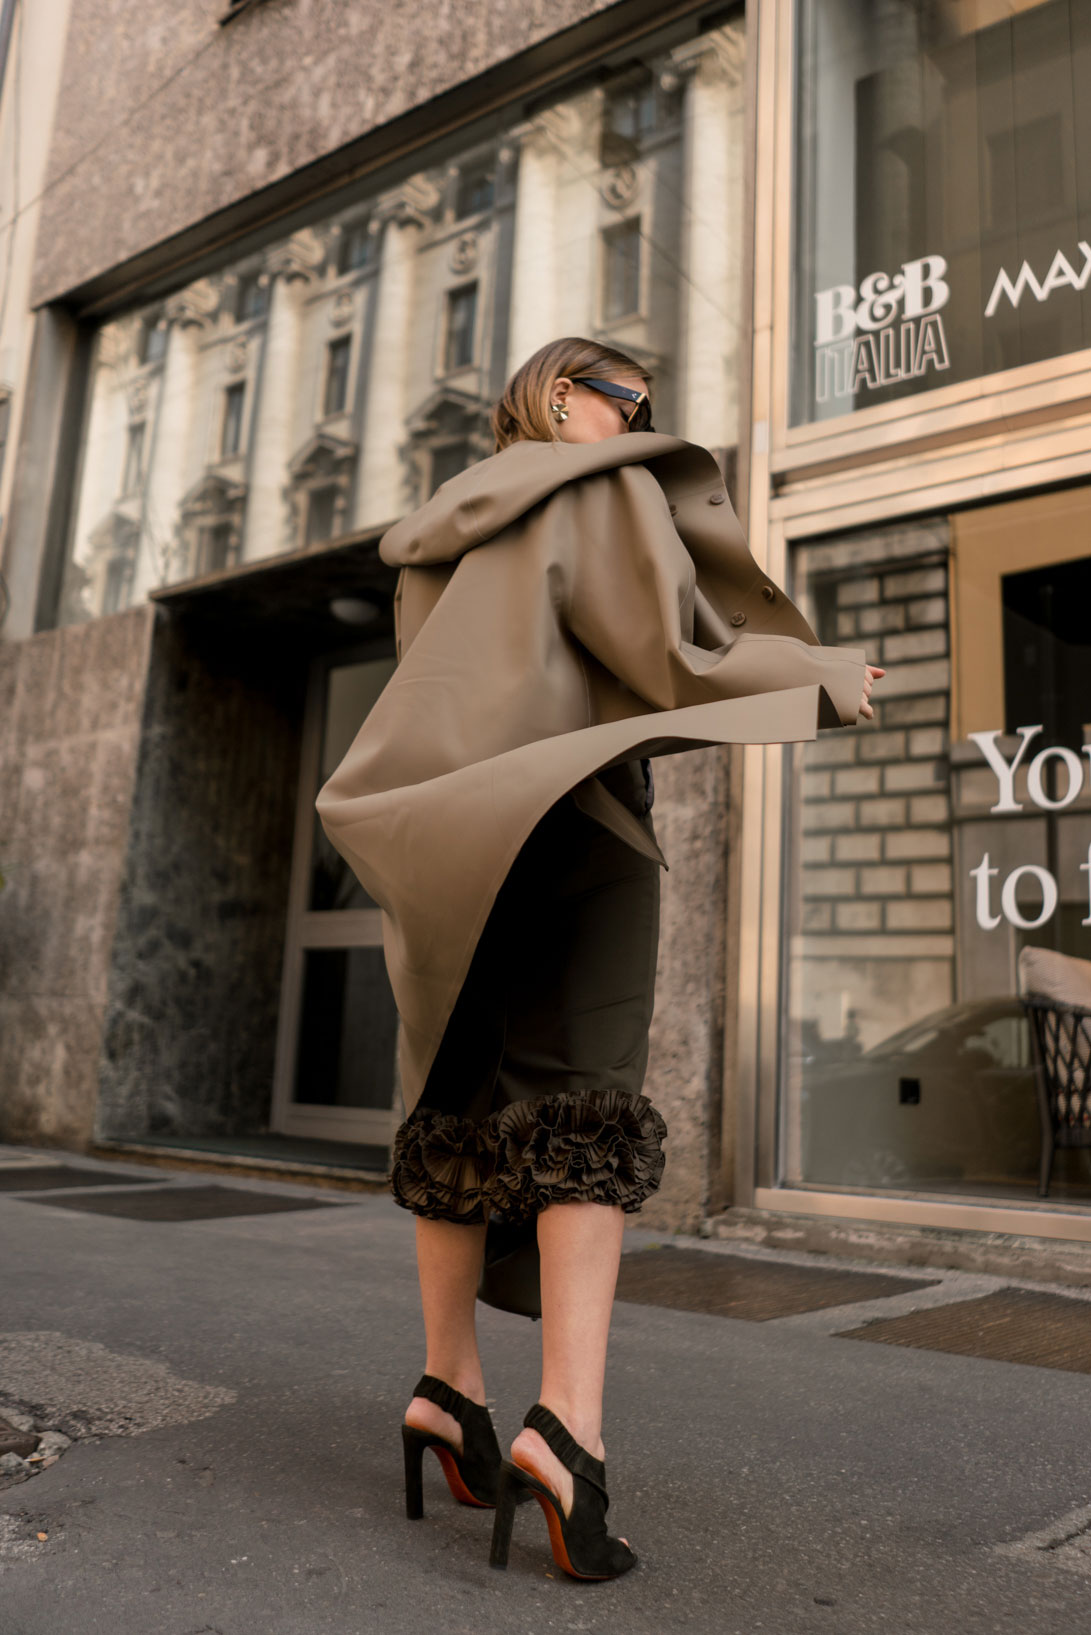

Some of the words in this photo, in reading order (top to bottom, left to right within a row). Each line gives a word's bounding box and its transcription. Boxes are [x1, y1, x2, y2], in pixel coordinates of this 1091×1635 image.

[814, 255, 950, 347] B&B
[815, 313, 950, 402] ITALIA
[967, 725, 1091, 813] Yo
[969, 852, 1058, 930] to
